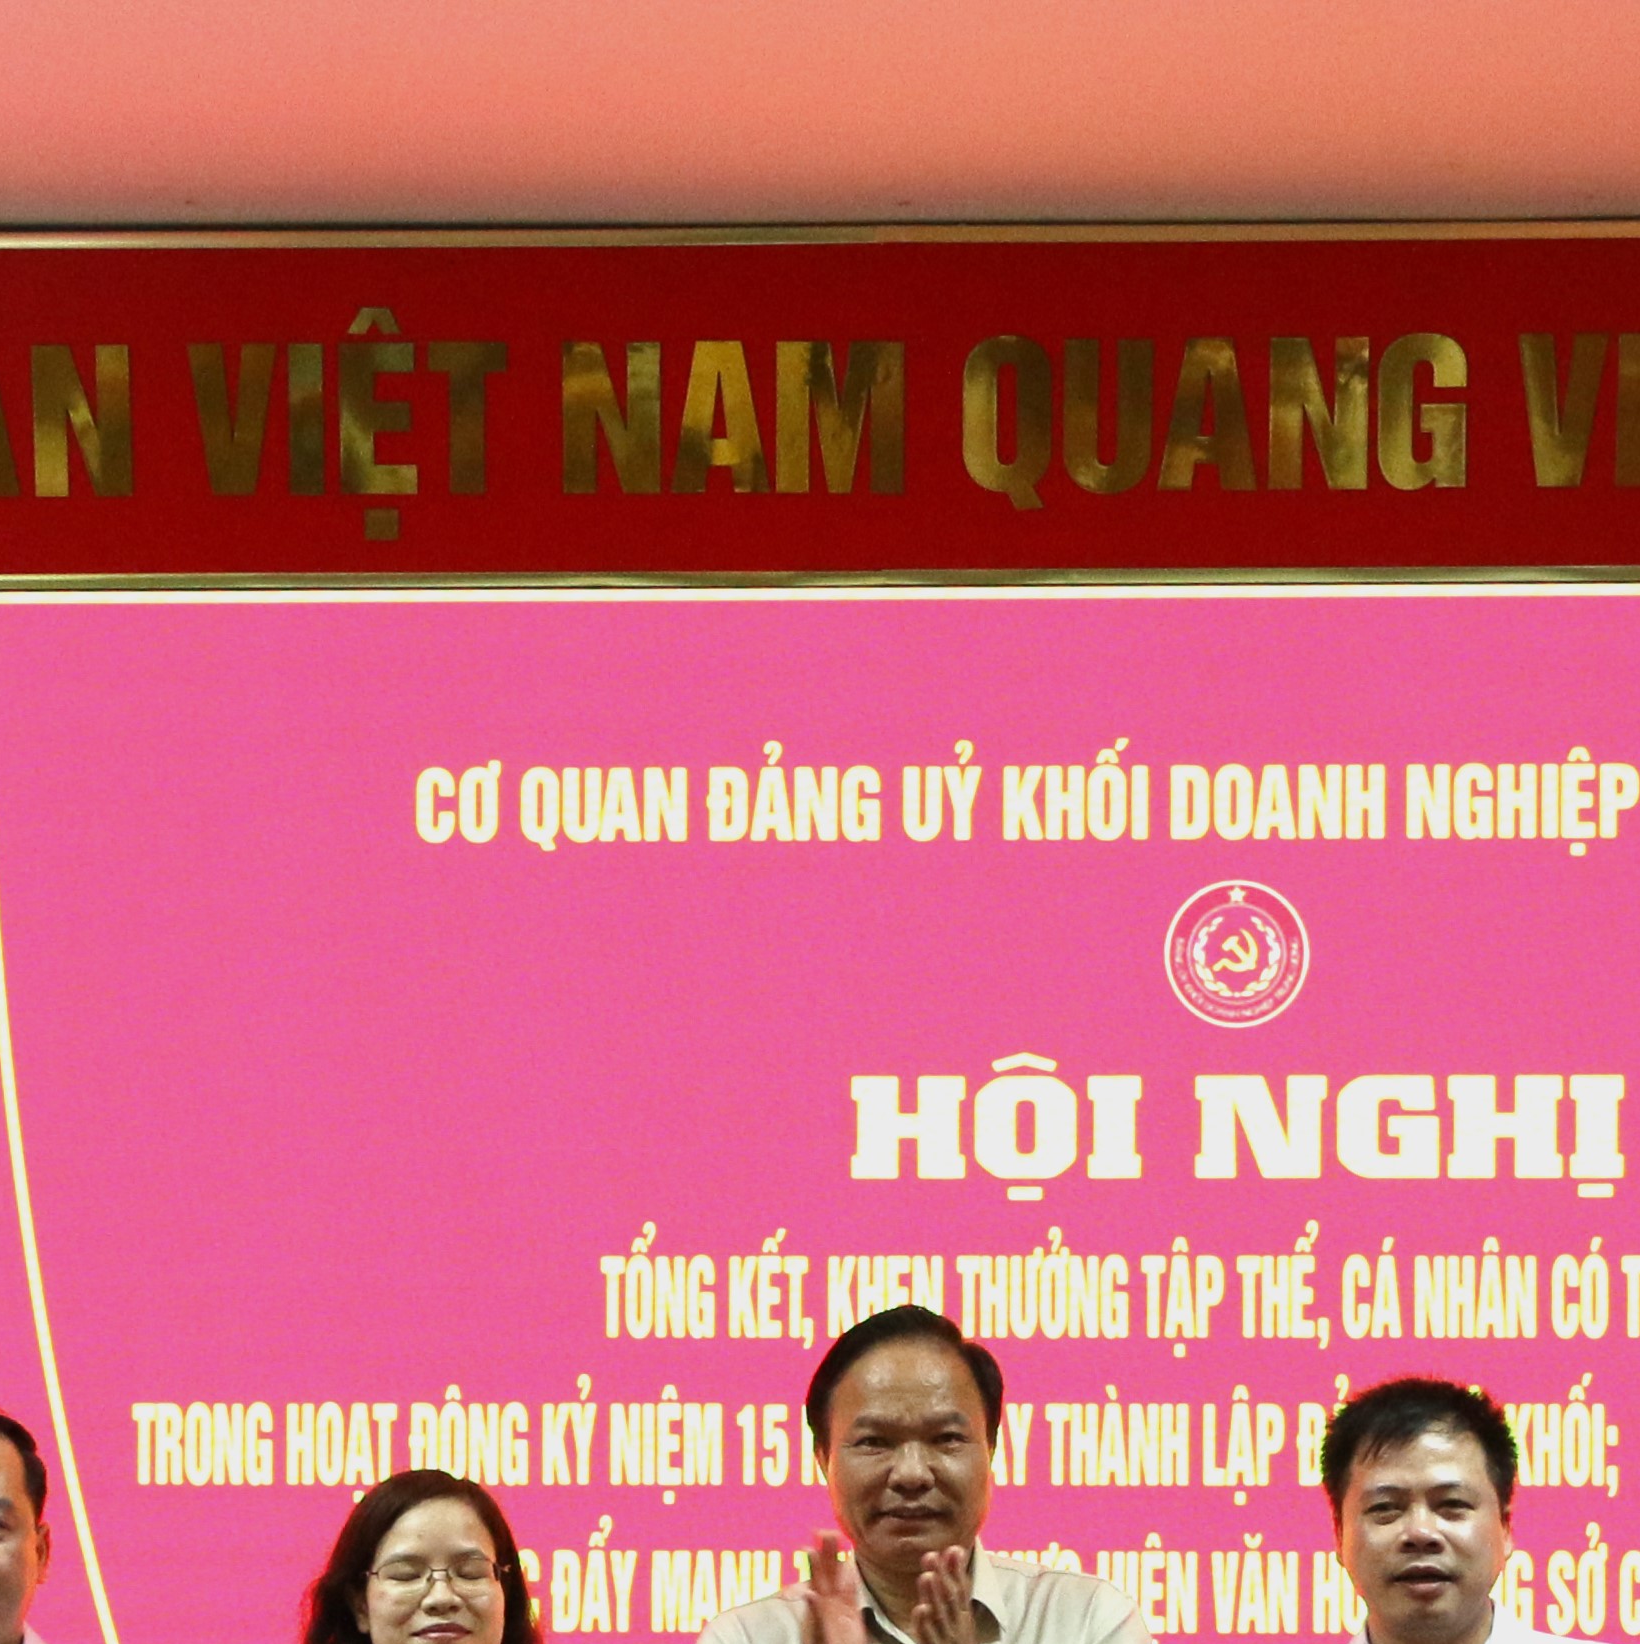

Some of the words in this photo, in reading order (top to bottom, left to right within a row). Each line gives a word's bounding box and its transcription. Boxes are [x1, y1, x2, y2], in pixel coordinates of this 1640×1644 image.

[187, 307, 508, 541] VIỆT
[562, 339, 905, 495] NAM
[962, 332, 1468, 511] QUANG
[416, 760, 501, 843] CƠ
[521, 766, 688, 851] QUAN
[706, 740, 881, 842] ĐẢNG
[1003, 738, 1149, 841] KHỐI
[1170, 764, 1386, 841] DOANH
[1406, 746, 1640, 857] NGHIỆP
[850, 1052, 1142, 1201] HỘI
[1194, 1074, 1626, 1199] NGHỊ
[600, 1221, 716, 1339] TỔNG
[728, 1228, 814, 1349] KẾT,
[956, 1226, 1129, 1339] THƯỞNG
[1141, 1236, 1225, 1358] TẬP
[1342, 1236, 1402, 1339] CÁ
[1414, 1236, 1538, 1338] NHÂN
[1551, 1236, 1610, 1339] CÓ
[131, 1401, 274, 1485] TRONG
[541, 1374, 598, 1486] KỶ
[610, 1384, 723, 1504] NIỆM
[736, 1403, 789, 1487] 15
[1045, 1384, 1189, 1486] THÀNH
[1202, 1384, 1286, 1506] LẬP
[551, 1514, 637, 1633] ĐẨY
[1212, 1532, 1299, 1634] VĂN
[1546, 1522, 1609, 1636] SỞ
